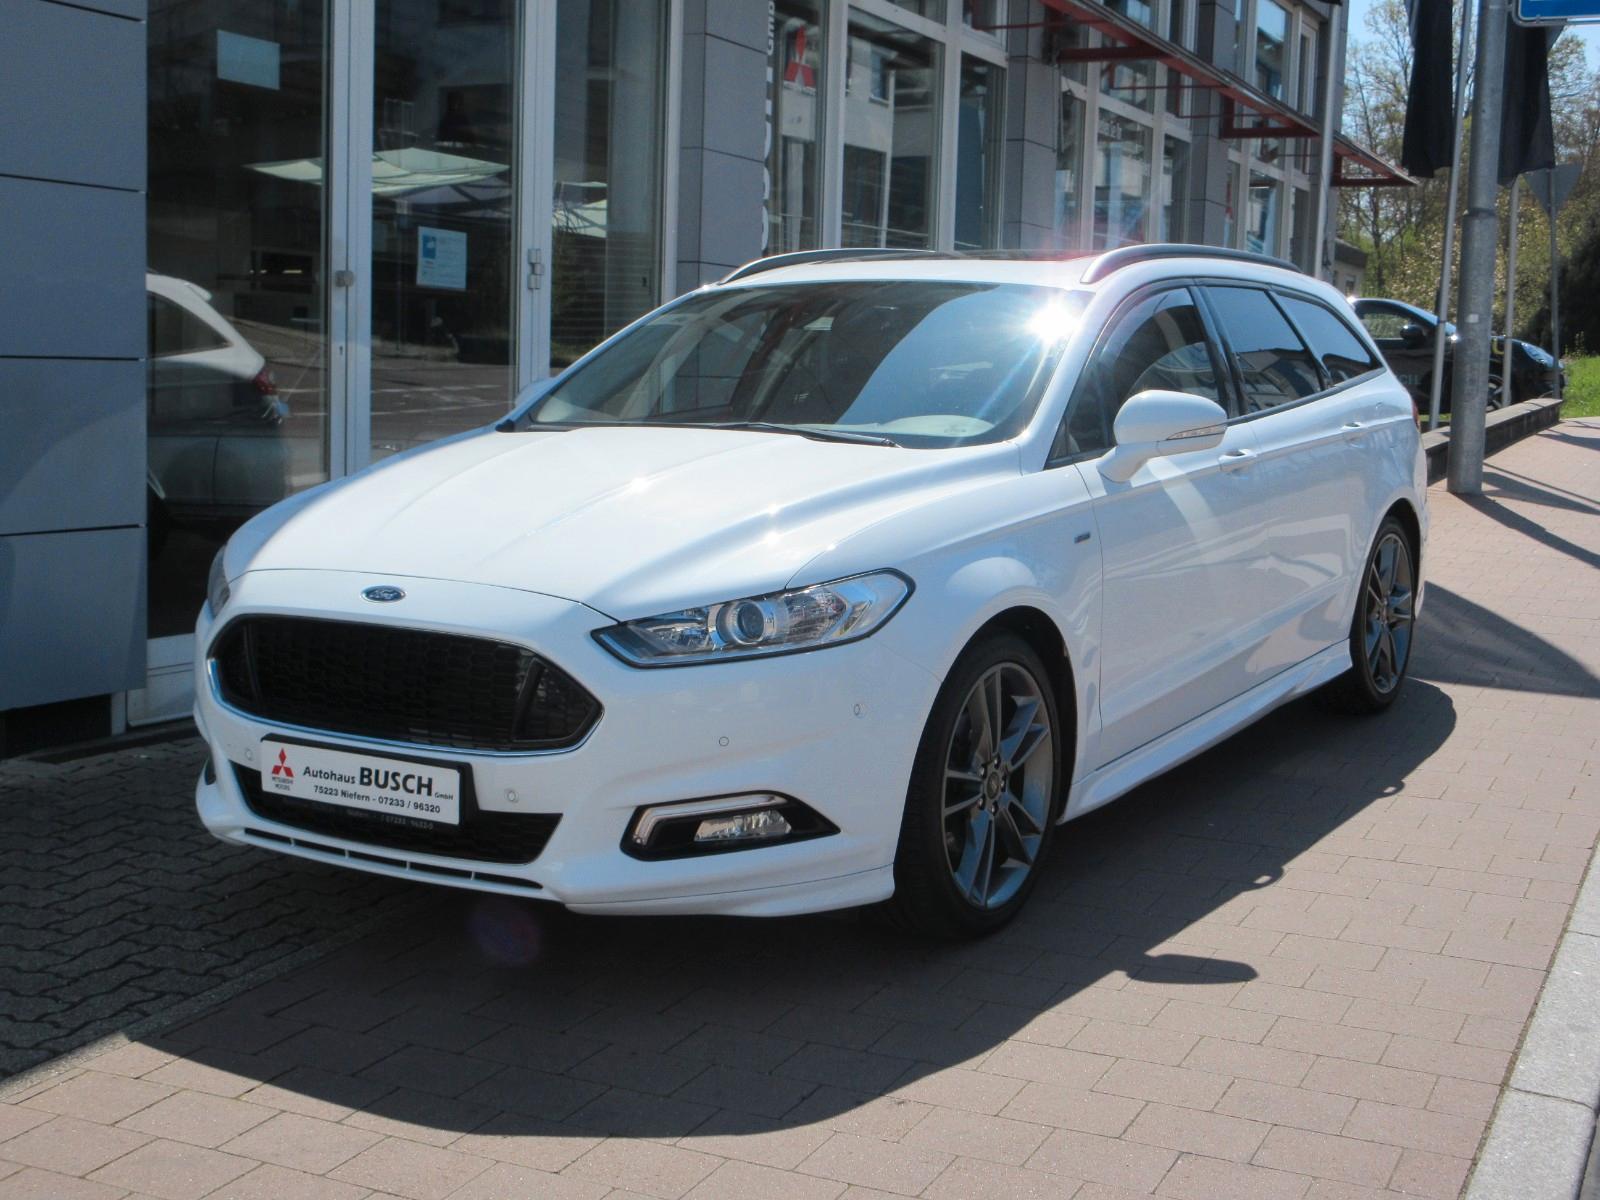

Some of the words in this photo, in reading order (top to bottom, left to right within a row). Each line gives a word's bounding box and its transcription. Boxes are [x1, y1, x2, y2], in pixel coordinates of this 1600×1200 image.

[303, 766, 356, 785] Autohaus
[359, 766, 433, 797] BUSCH
[434, 791, 455, 801] GmbH
[313, 785, 339, 798] 75223
[340, 787, 371, 803] Niefern
[378, 796, 405, 808] 07233
[413, 801, 440, 814] 96320
